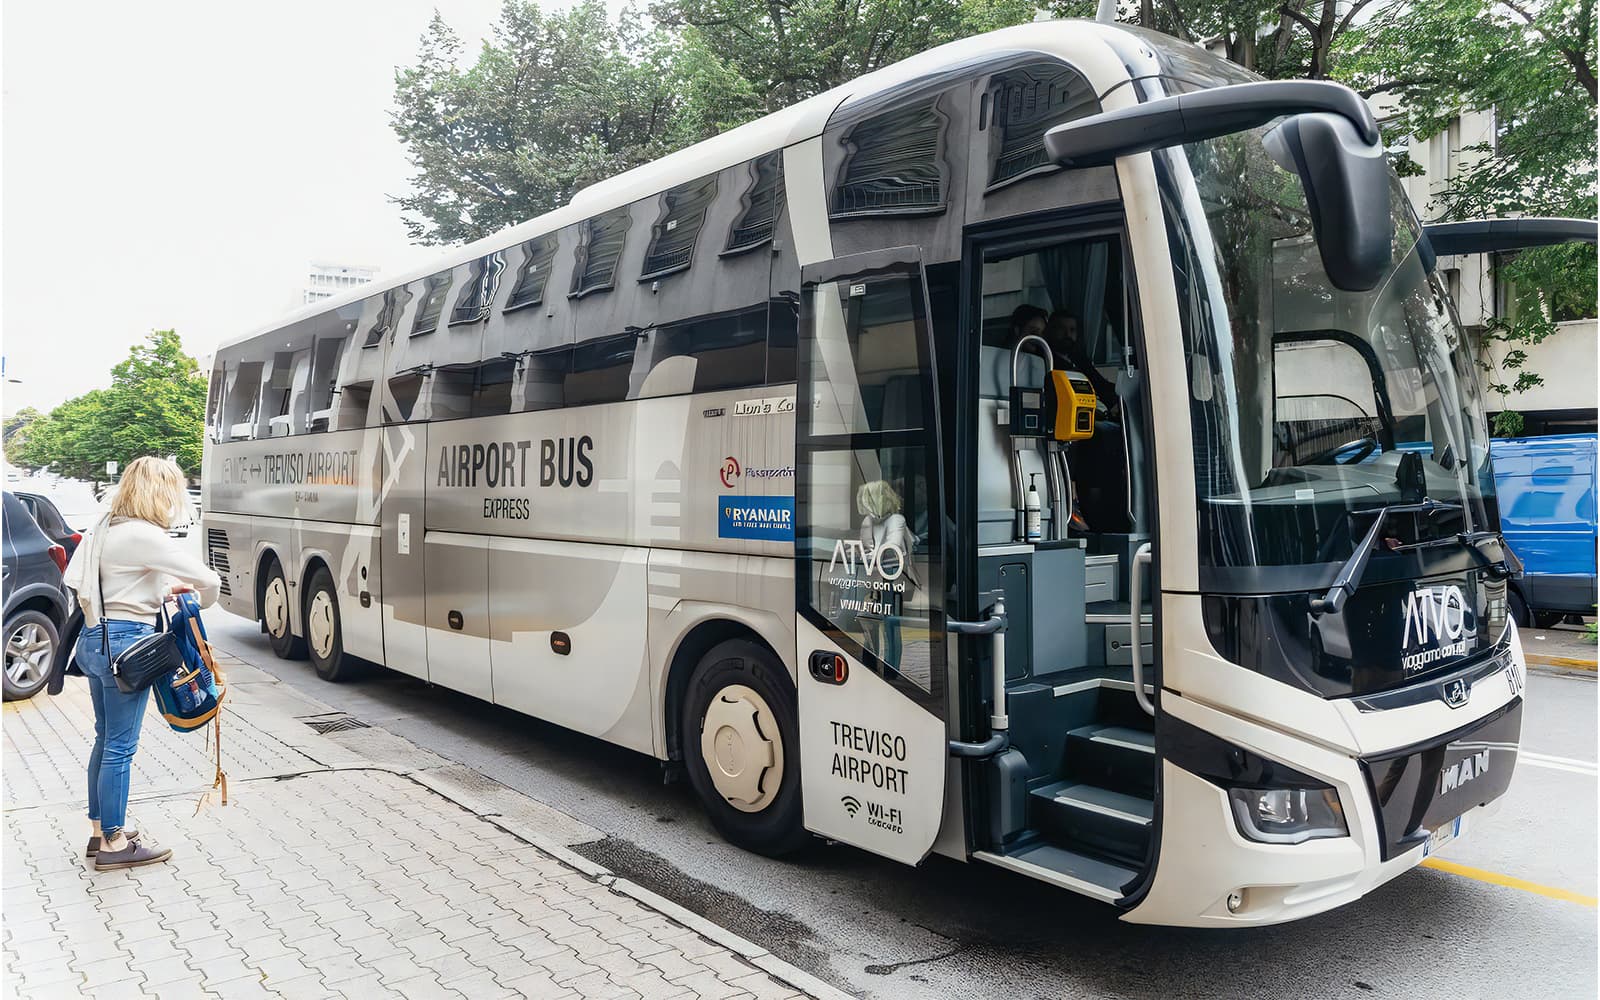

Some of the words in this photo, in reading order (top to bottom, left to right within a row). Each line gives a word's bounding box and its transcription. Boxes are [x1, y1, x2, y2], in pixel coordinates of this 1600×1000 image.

[264, 453, 303, 485] TREVISO
[306, 450, 358, 486] AIRPORT
[437, 440, 531, 488] AIRPORT
[540, 435, 594, 488] BUS
[483, 498, 530, 519] EXPRESS
[733, 508, 791, 522] RYANAIR
[829, 539, 904, 580] ATVO
[1402, 585, 1464, 649] ATVO
[830, 721, 906, 761] TREVISO
[832, 753, 908, 794] AIRPORT
[1440, 748, 1489, 795] MAN
[867, 801, 902, 825] WI-FI
